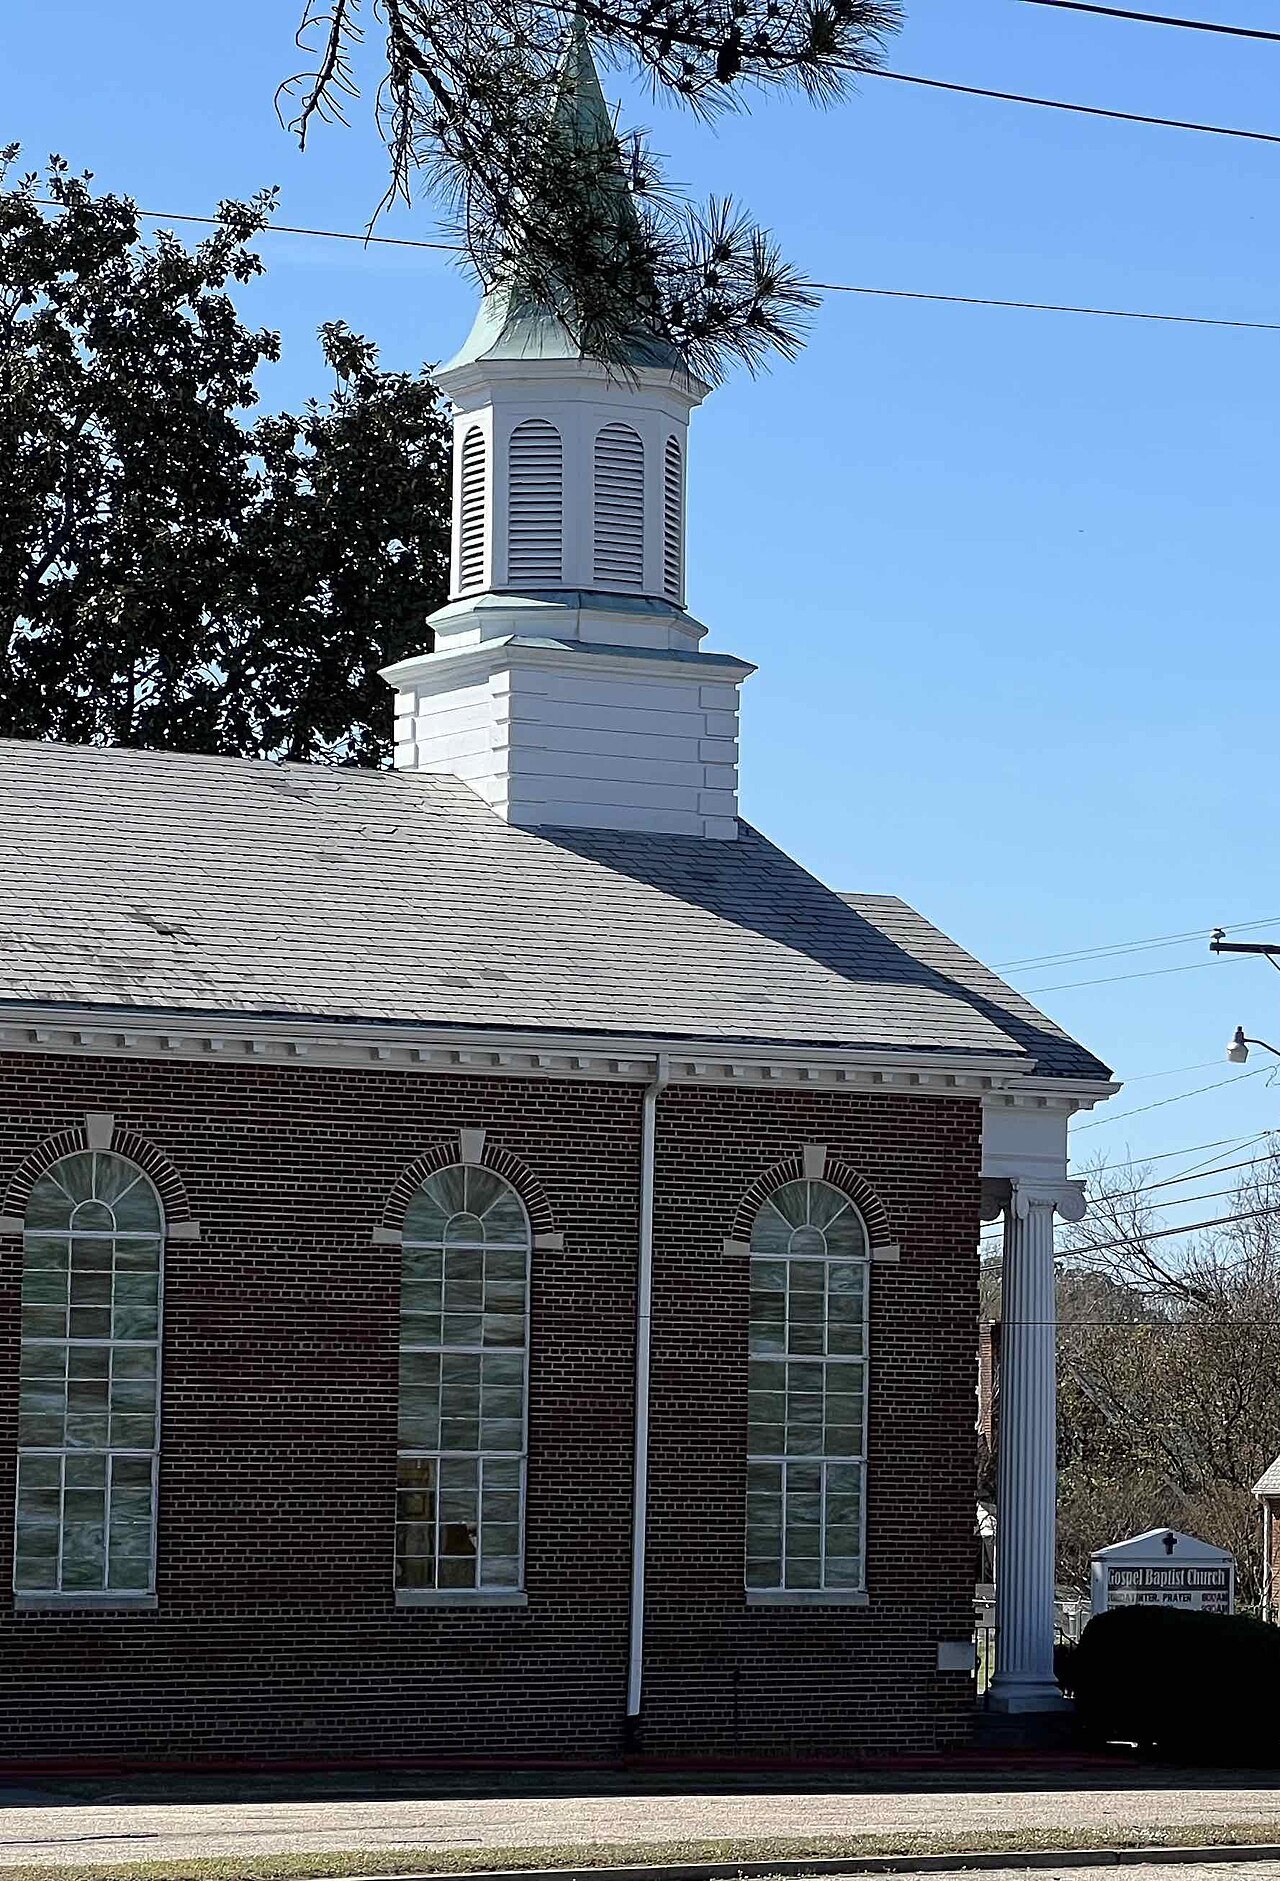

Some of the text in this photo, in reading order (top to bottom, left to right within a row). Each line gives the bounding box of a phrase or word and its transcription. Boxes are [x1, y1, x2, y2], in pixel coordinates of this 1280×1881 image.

[1108, 1568, 1225, 1588] Gospel Baptist Church
[1162, 1593, 1192, 1602] PRAYER
